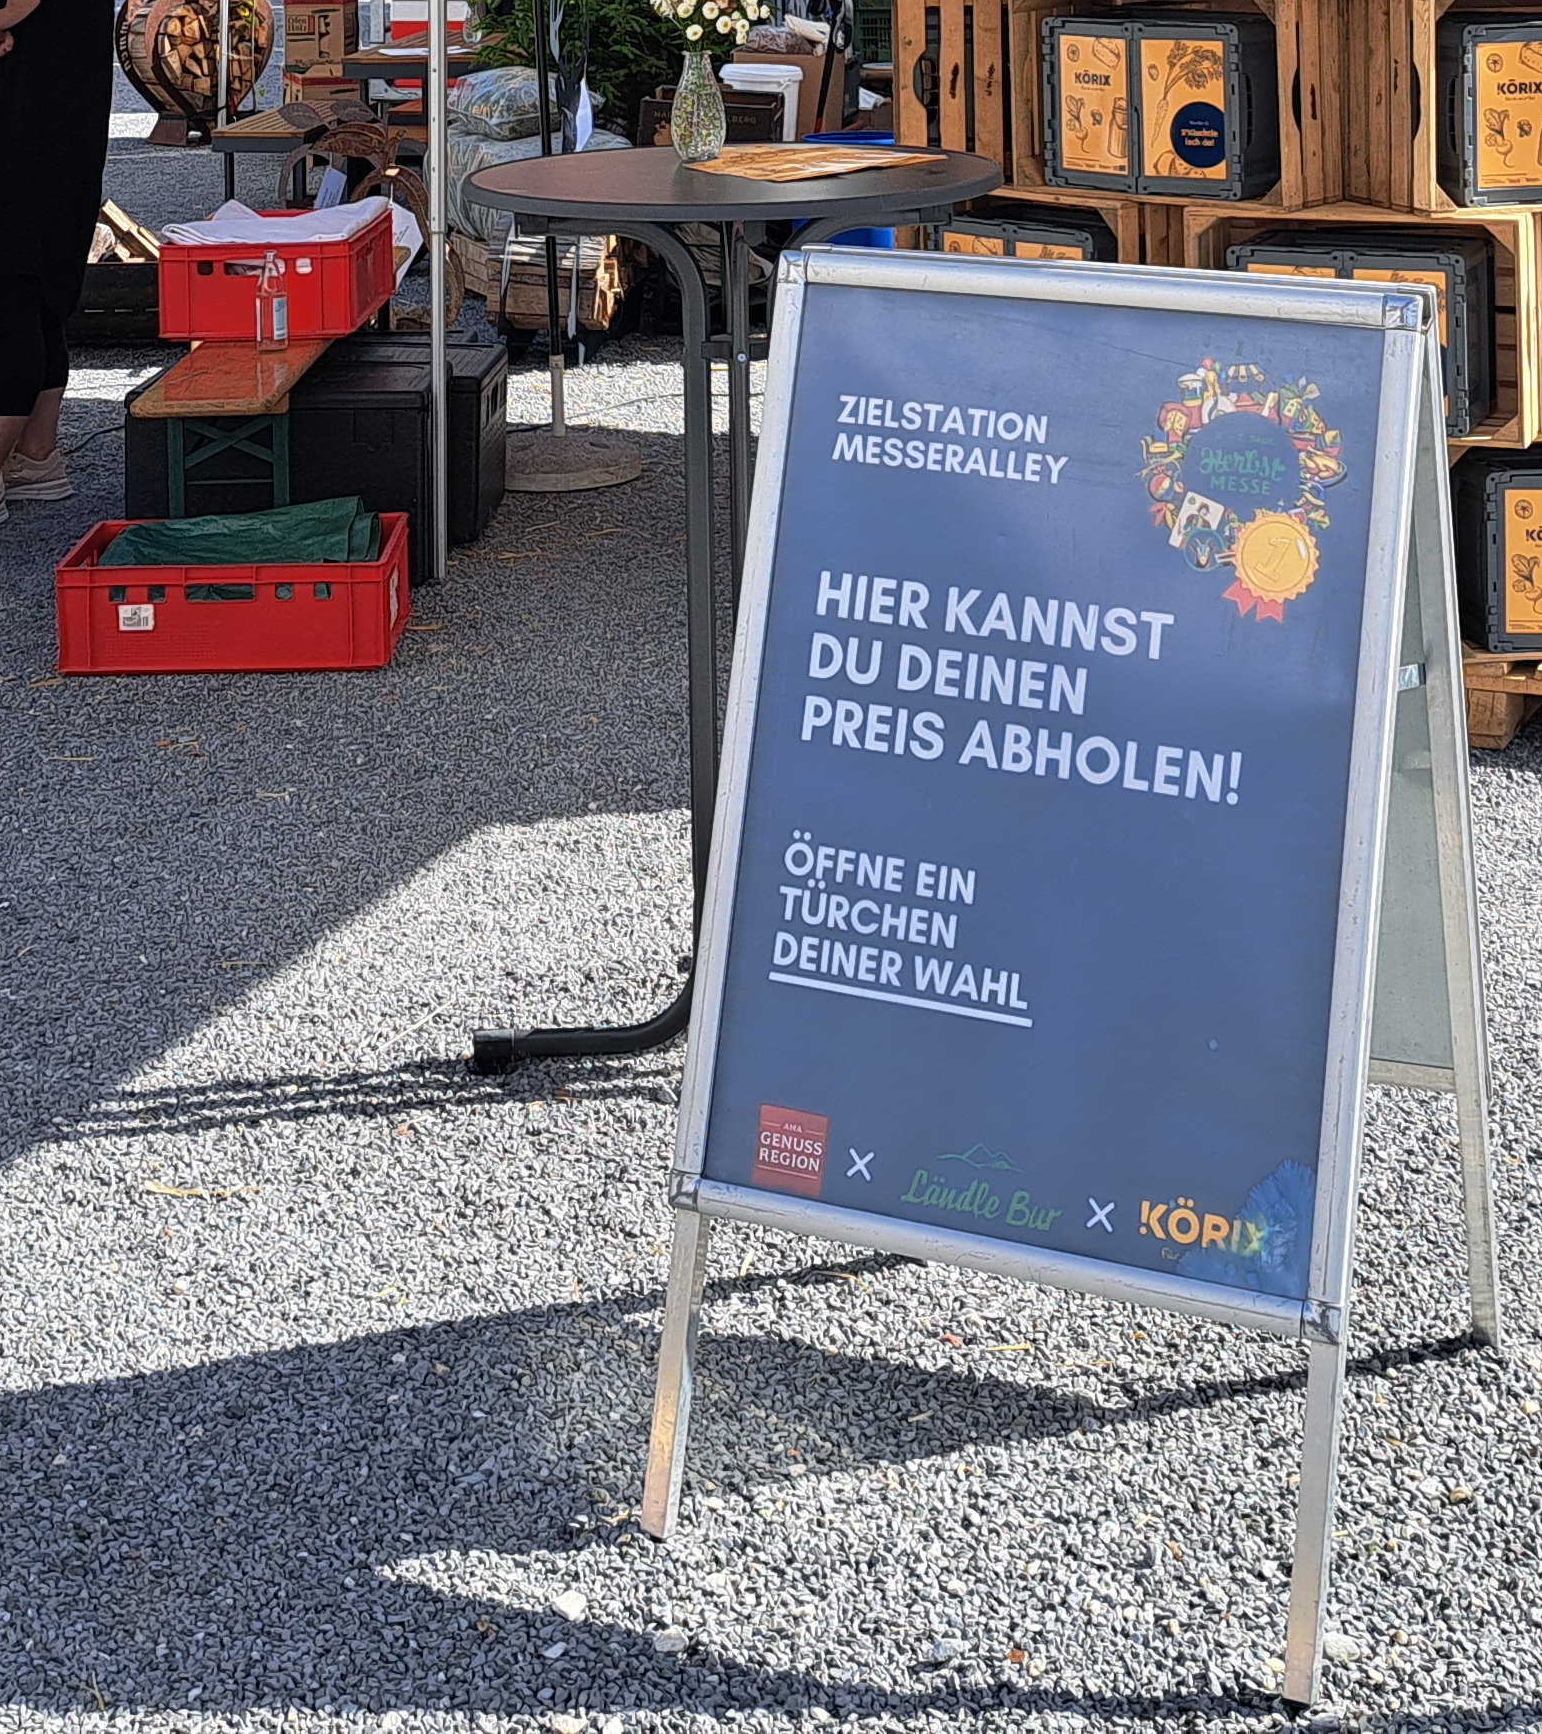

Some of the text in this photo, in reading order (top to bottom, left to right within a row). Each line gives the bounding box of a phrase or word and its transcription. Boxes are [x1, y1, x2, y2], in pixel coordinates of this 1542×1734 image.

[837, 395, 1049, 445] ZIELSTATION
[832, 432, 1070, 485] MESSERALLEY
[1209, 475, 1271, 495] MESSE
[815, 570, 1175, 660] HIER KANNST
[808, 632, 1089, 715] DU DEINEN
[801, 696, 1244, 806] PREIS ABHOLEN!
[784, 829, 977, 906] ÖFFNE EIN
[779, 878, 958, 949] TÜRCHEN
[773, 931, 1030, 1012] DEINER WAHL
[758, 1147, 821, 1173] REGION
[760, 1131, 823, 1156] GENUSS
[900, 1168, 1062, 1233] Ländle Bur
